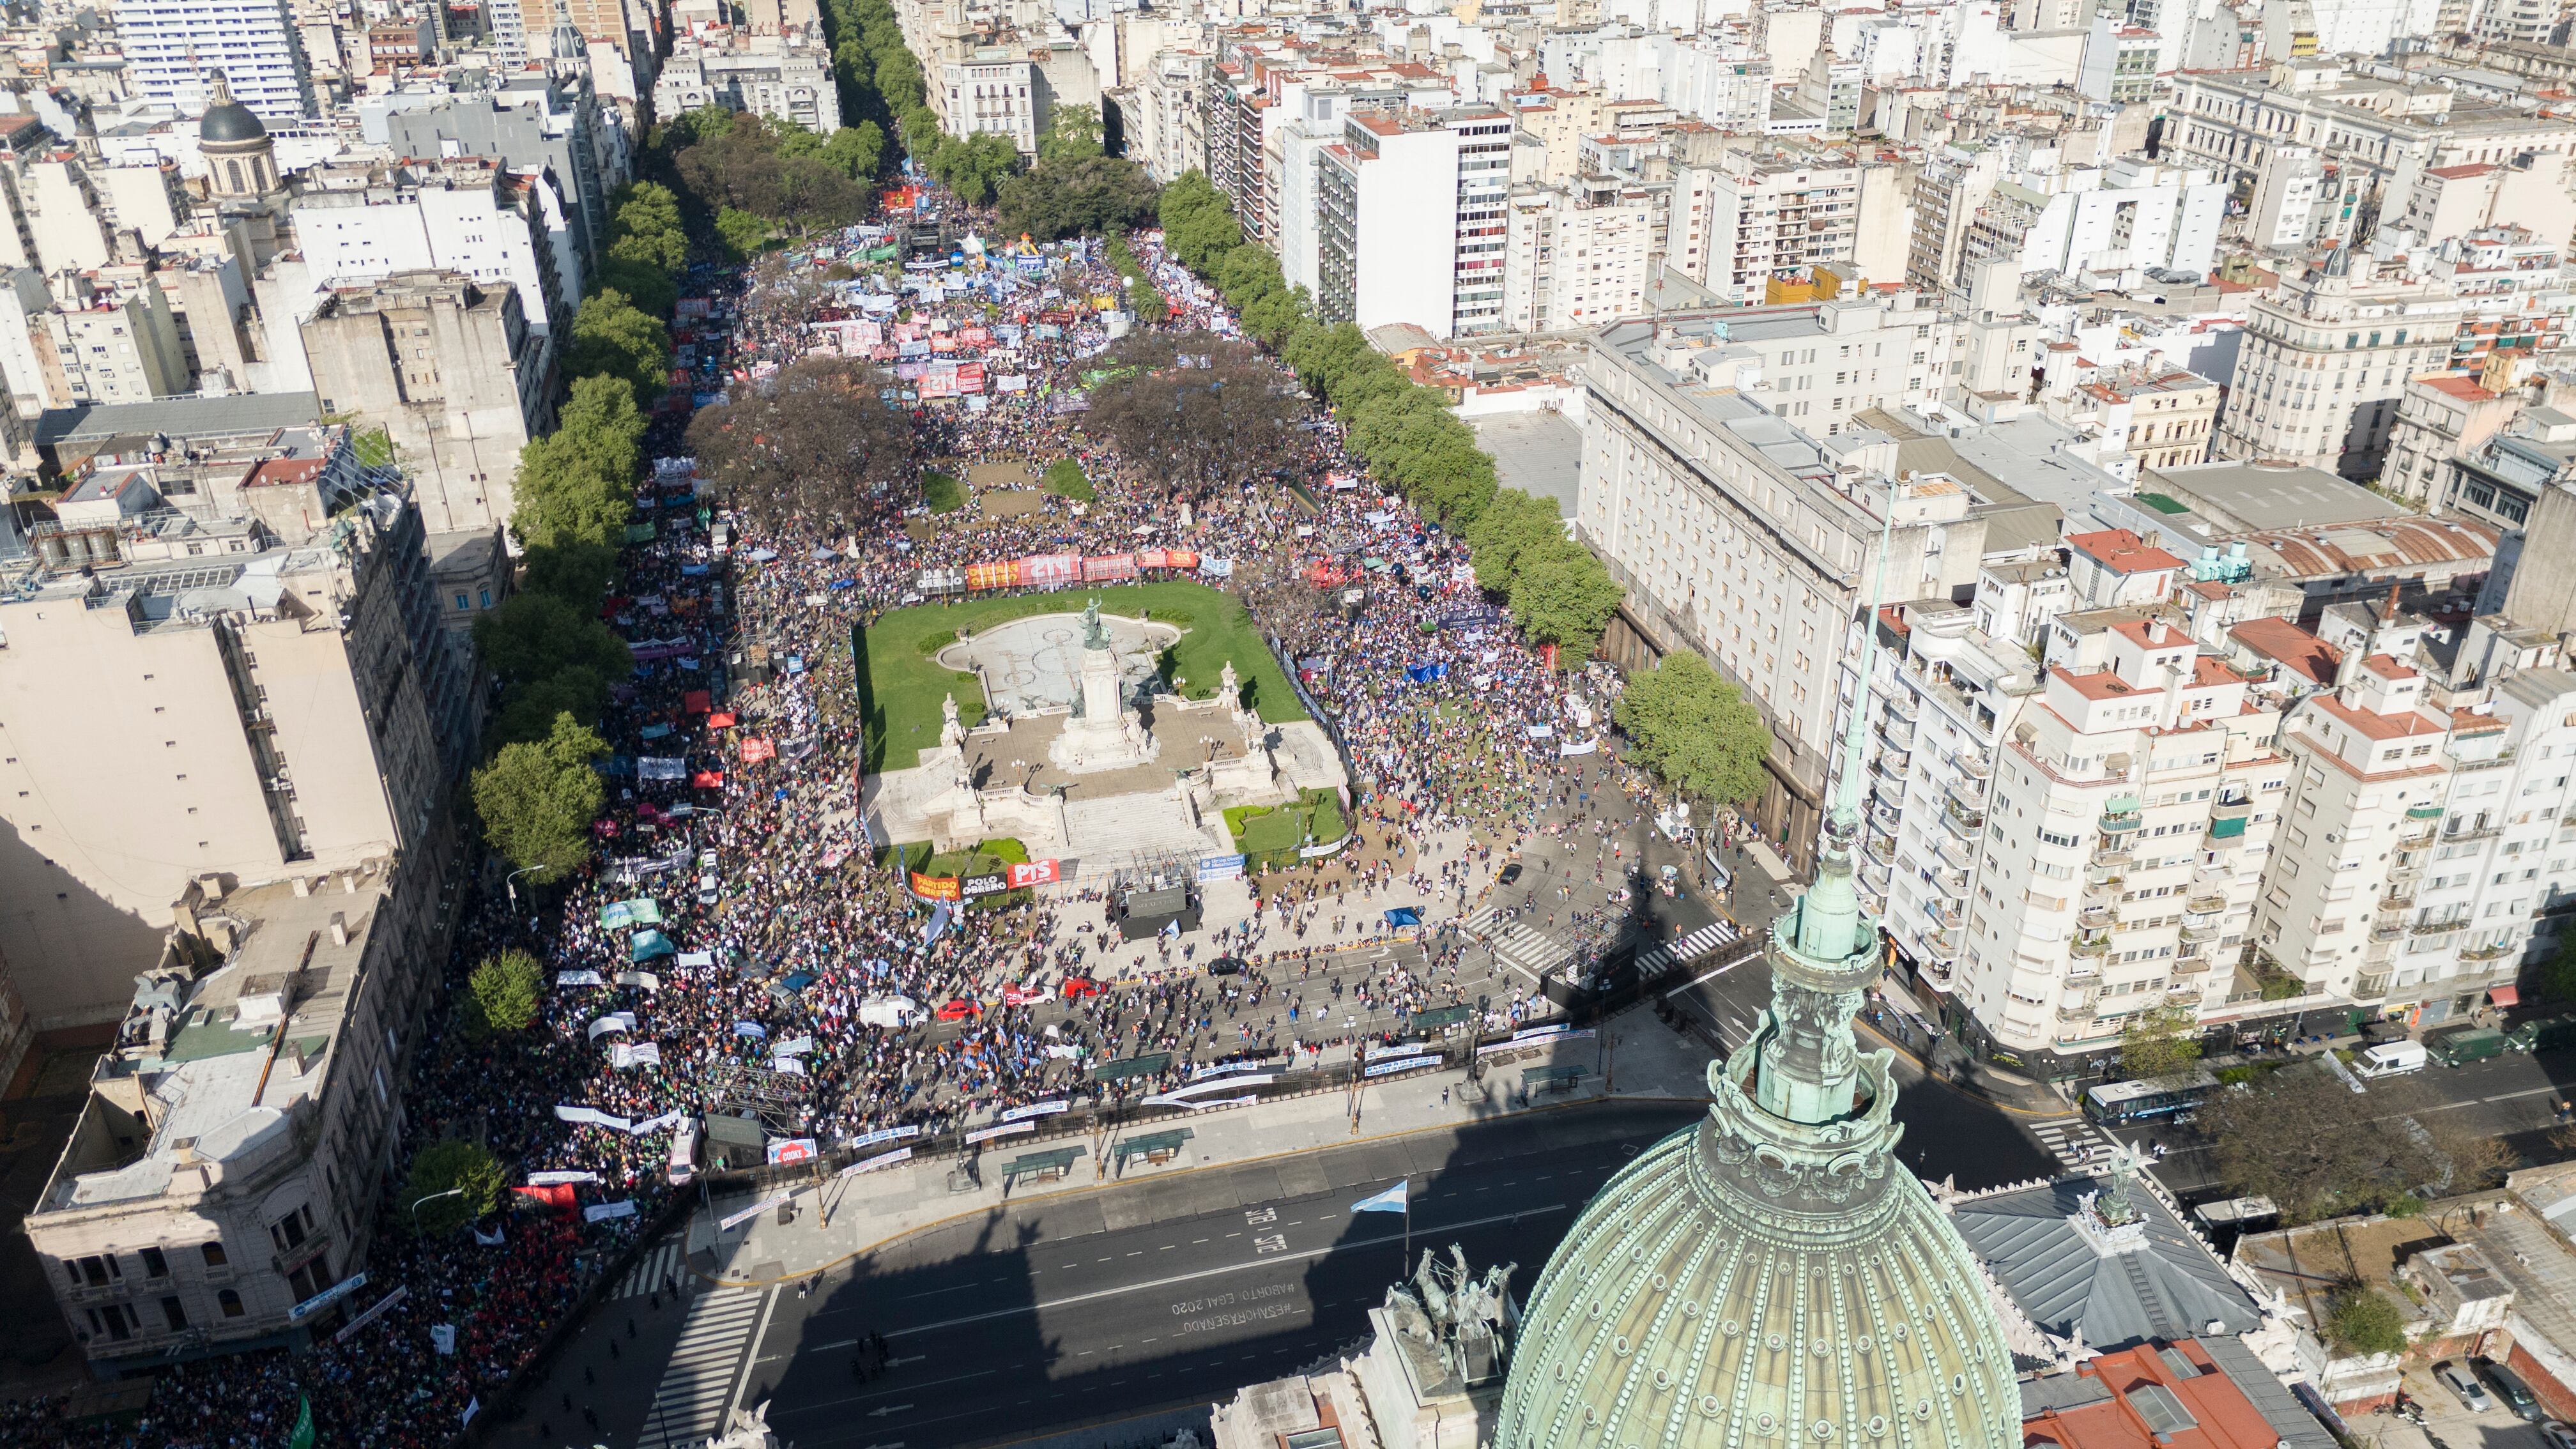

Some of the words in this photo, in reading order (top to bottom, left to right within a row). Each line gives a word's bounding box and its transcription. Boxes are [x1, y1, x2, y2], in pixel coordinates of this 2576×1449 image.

[1310, 169, 1319, 194] ibis
[1310, 197, 1319, 231] hotel
[1015, 861, 1051, 882] PTS
[916, 877, 957, 890] PARTIDO
[967, 876, 998, 887] POLO
[917, 885, 957, 897] OBRERO
[962, 882, 1006, 895] OBRERO
[783, 1149, 802, 1162] COOKE
[1184, 1303, 1292, 1332] #ESAHORASENADO
